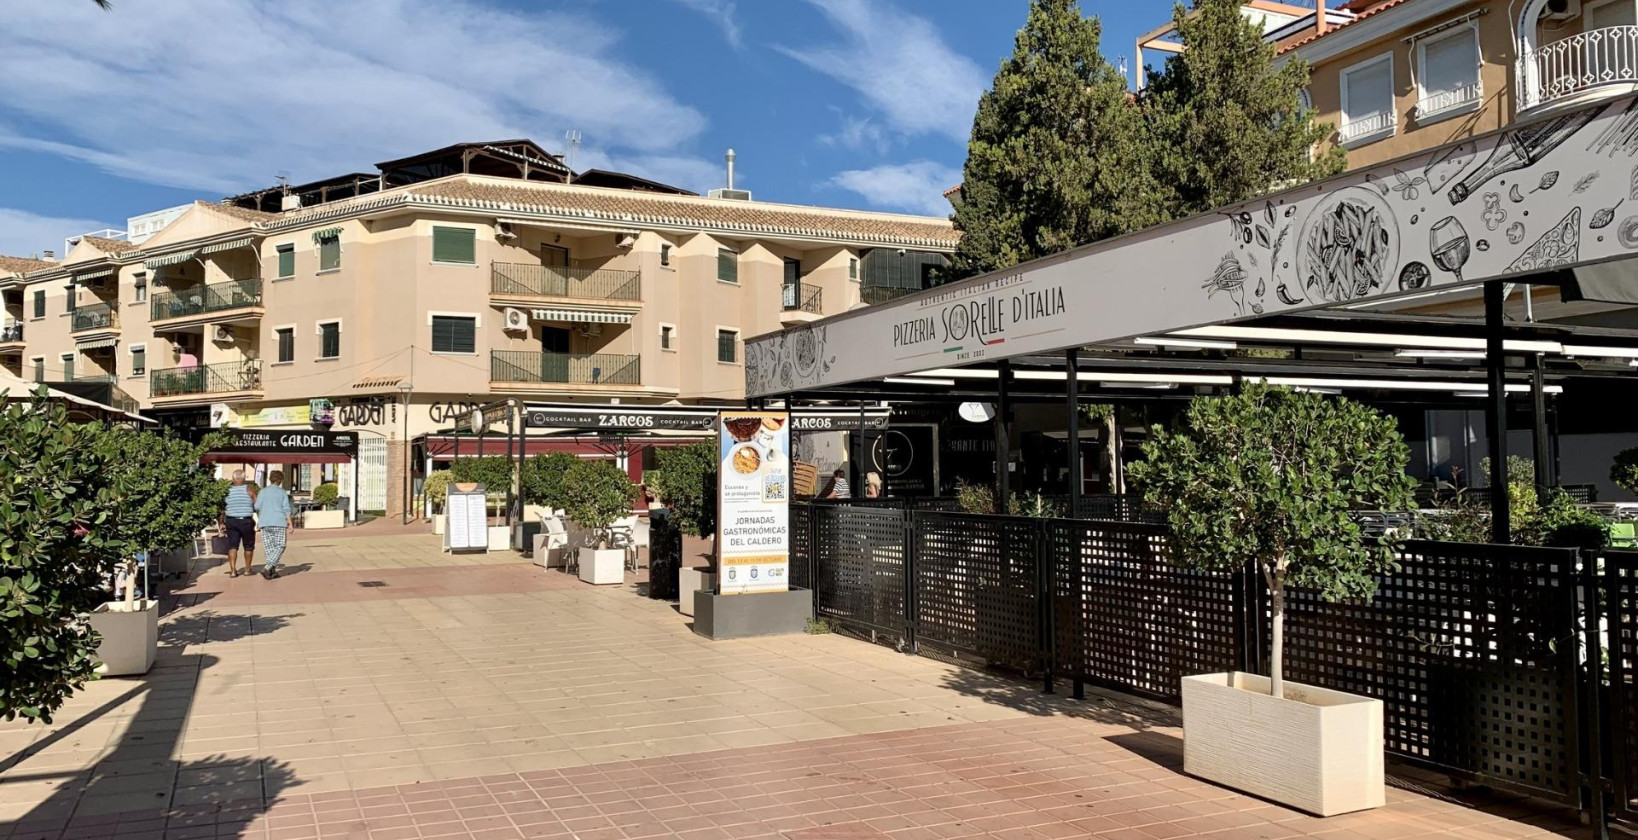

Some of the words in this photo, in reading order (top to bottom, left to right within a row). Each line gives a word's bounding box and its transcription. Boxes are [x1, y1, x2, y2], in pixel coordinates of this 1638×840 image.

[920, 290, 957, 306] AUTHENTIC
[960, 282, 991, 296] ITALIAN
[995, 273, 1024, 287] RECIPE
[893, 316, 936, 348] PIZZERIA
[942, 296, 1005, 346] SORELLE
[1012, 286, 1066, 324] D'ITALIA
[339, 403, 385, 427] GARDEN
[599, 414, 654, 427] ZARCOS
[792, 418, 832, 429] ARCOS
[242, 433, 270, 441] PIZZERIA
[279, 434, 325, 448] GARDEN
[735, 516, 776, 525] JORNADAS
[723, 525, 787, 536] GASTRONÓMICAS
[730, 538, 745, 546] DEL
[747, 536, 782, 546] CALDERO
